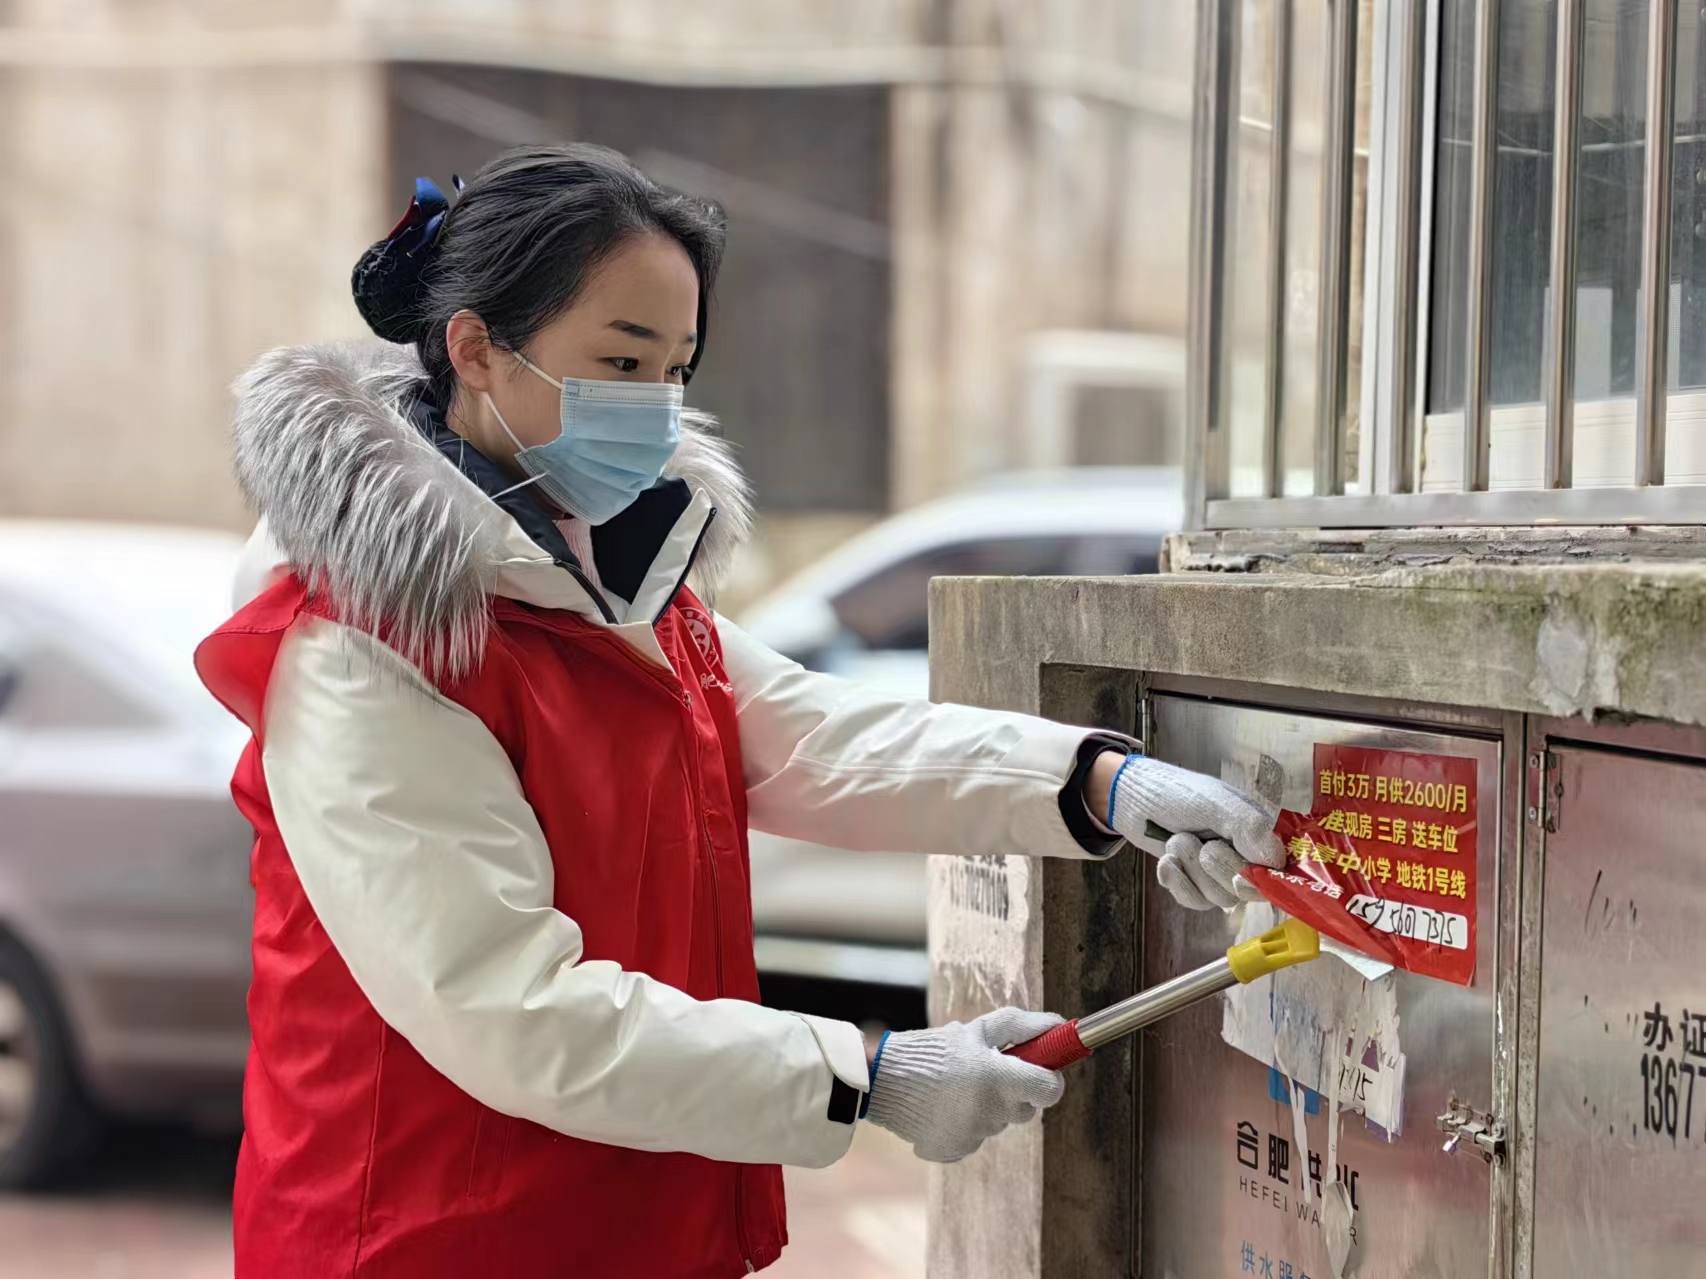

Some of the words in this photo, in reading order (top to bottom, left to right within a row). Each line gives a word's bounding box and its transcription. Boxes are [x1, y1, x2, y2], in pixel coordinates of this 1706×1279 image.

[1319, 768, 1370, 799] 首付3万
[1375, 776, 1467, 813] 月供2600/月
[1378, 816, 1407, 845] 三房
[1411, 820, 1459, 853] 送车位
[1396, 860, 1467, 900] 地铁1号线
[1641, 1053, 1706, 1143] 1367
[1239, 1175, 1288, 1213] HEFEI
[1296, 1201, 1358, 1246] WAR
[1241, 1240, 1312, 1279] 供水服
